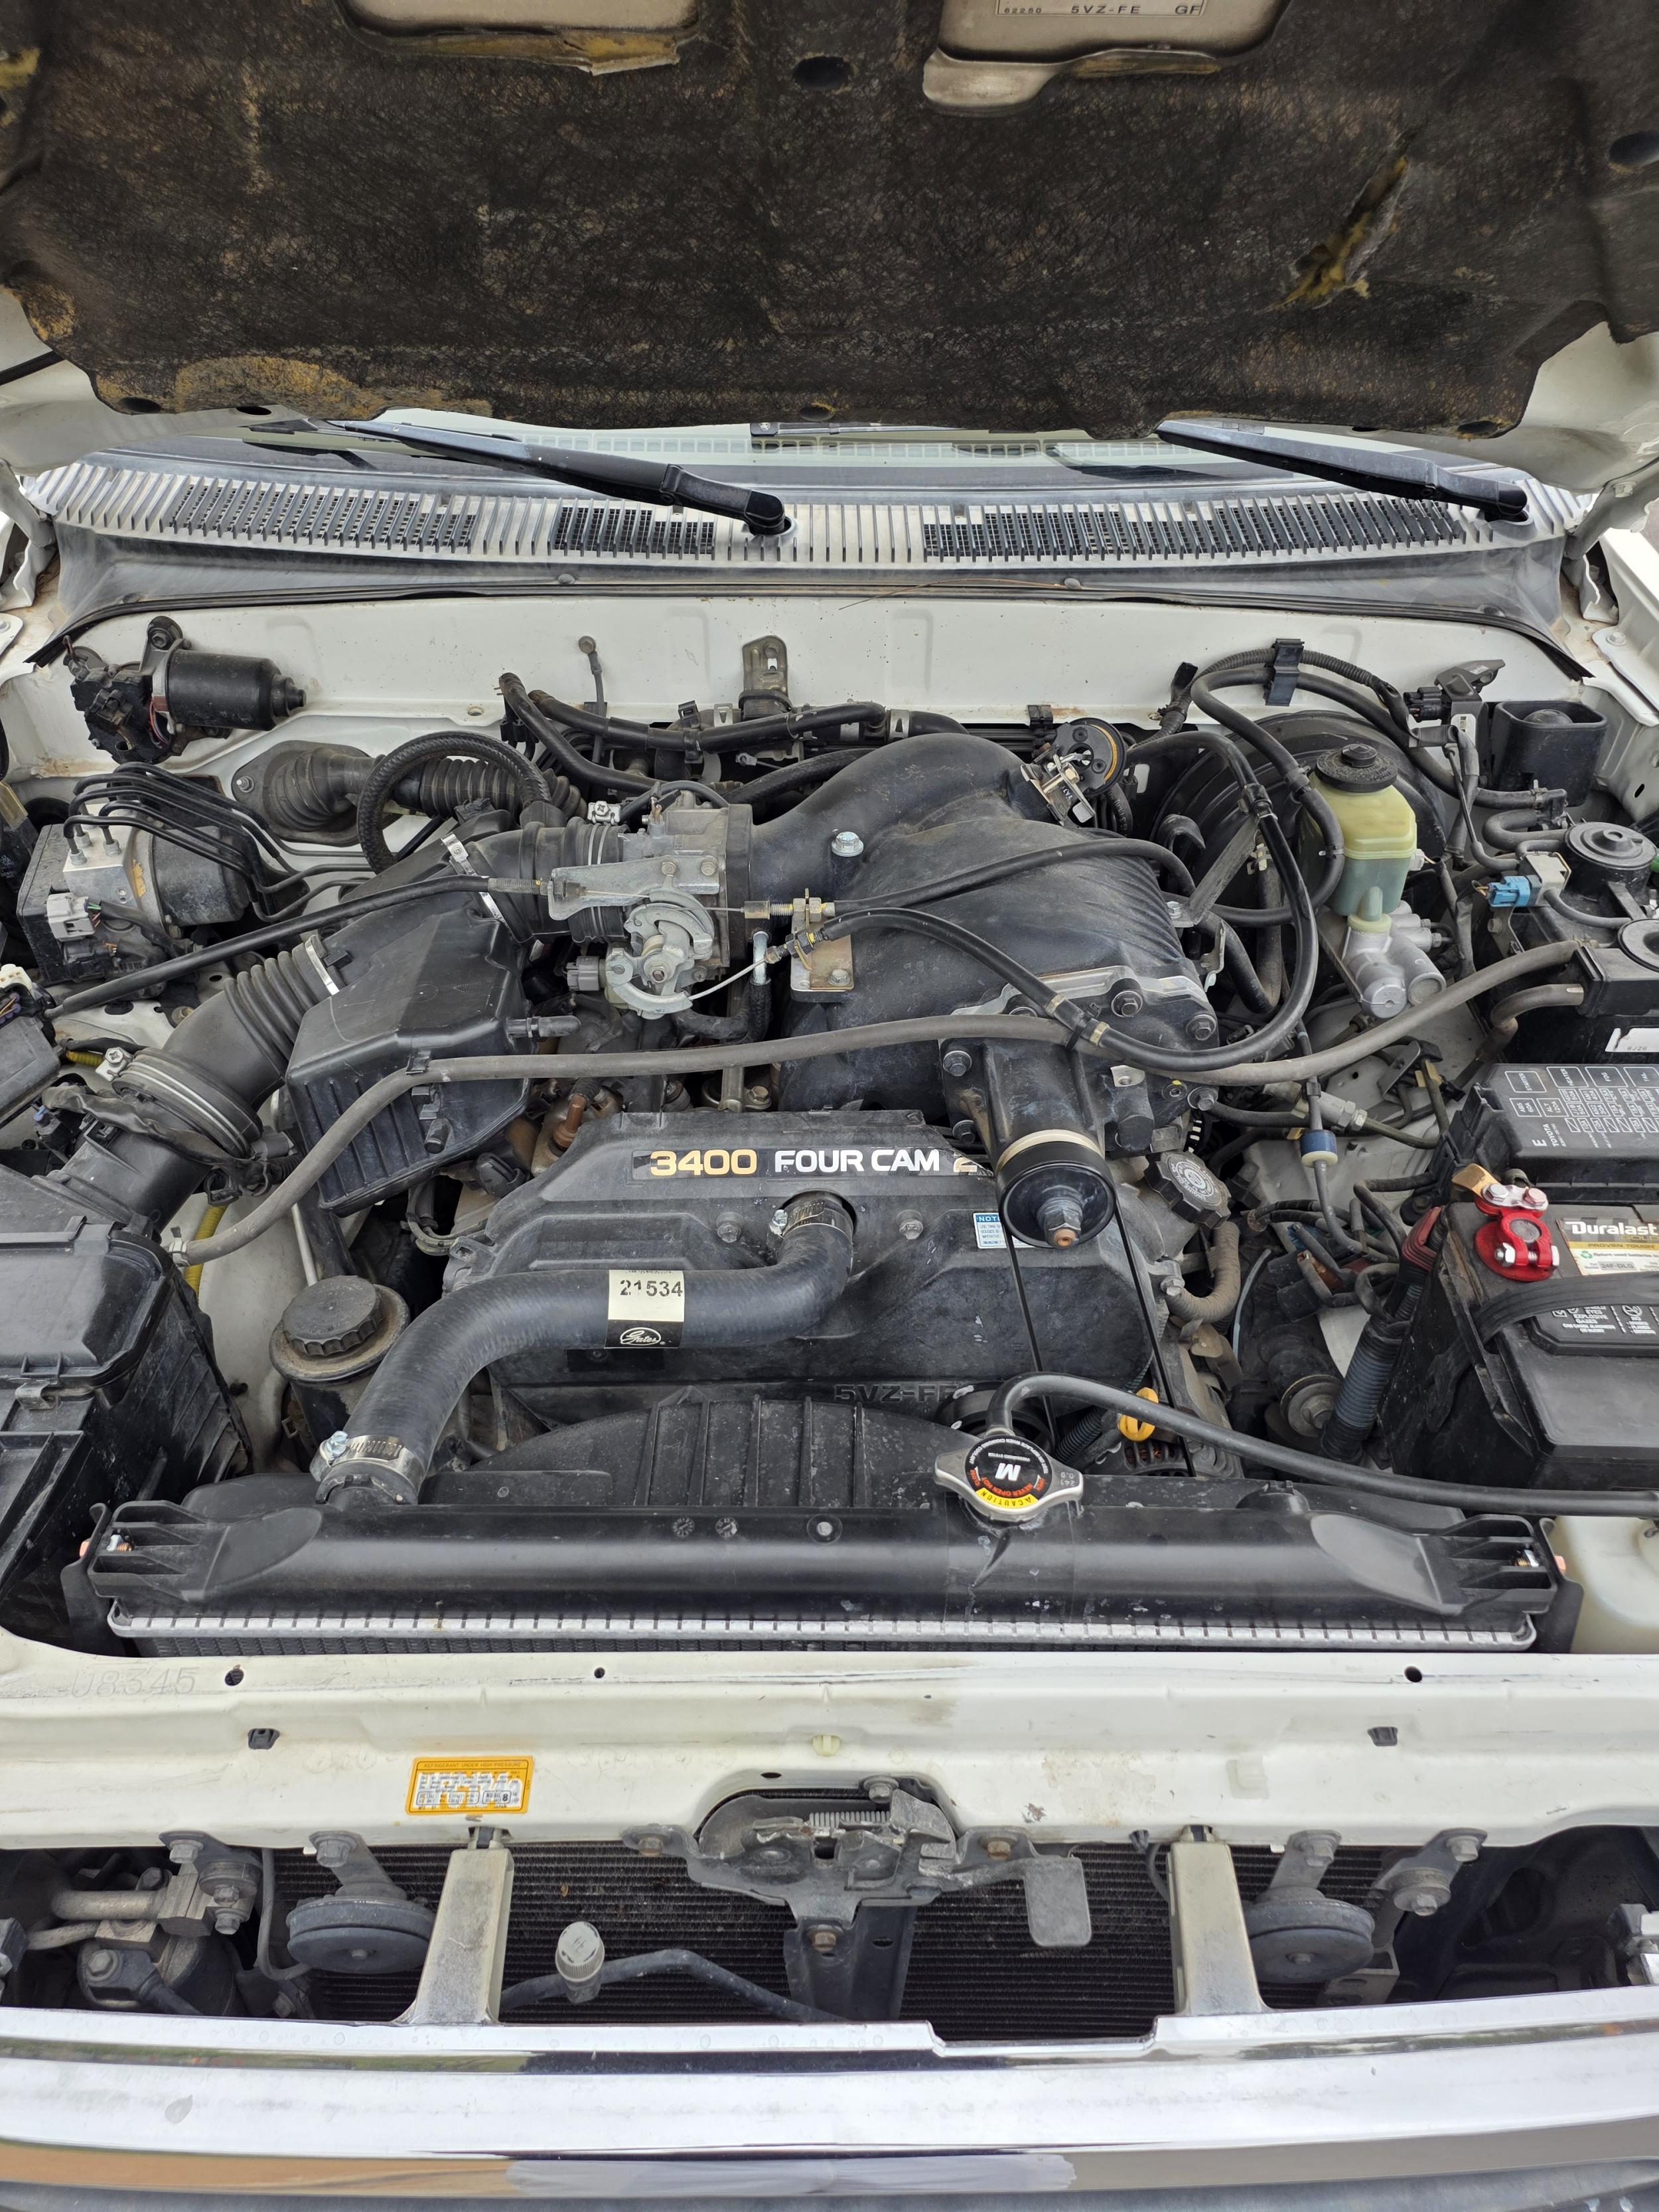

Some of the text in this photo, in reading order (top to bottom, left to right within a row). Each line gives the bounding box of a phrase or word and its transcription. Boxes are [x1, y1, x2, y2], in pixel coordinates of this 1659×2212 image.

[1071, 5, 1141, 14] 5VZ-FE
[1519, 1072, 1532, 1091] STARTER
[1560, 1068, 1575, 1086] HEATER
[1601, 1072, 1611, 1082] FOG
[1517, 1102, 1526, 1113] ABS
[1544, 1102, 1553, 1113] ALT
[1551, 1101, 1561, 1114] 120A
[1543, 1123, 1559, 1147] TOYOTA
[650, 1149, 757, 1176] 3400
[774, 1149, 865, 1173] FOUR
[871, 1148, 940, 1173] CAM
[1565, 1221, 1659, 1236] Duralast
[620, 1280, 683, 1297] 21534
[622, 1329, 660, 1345] Gates
[991, 1486, 1012, 1497] OPEN
[1012, 1483, 1033, 1497] NEVER
[981, 1491, 1023, 1507] CAUTION
[502, 1793, 508, 1802] 8
